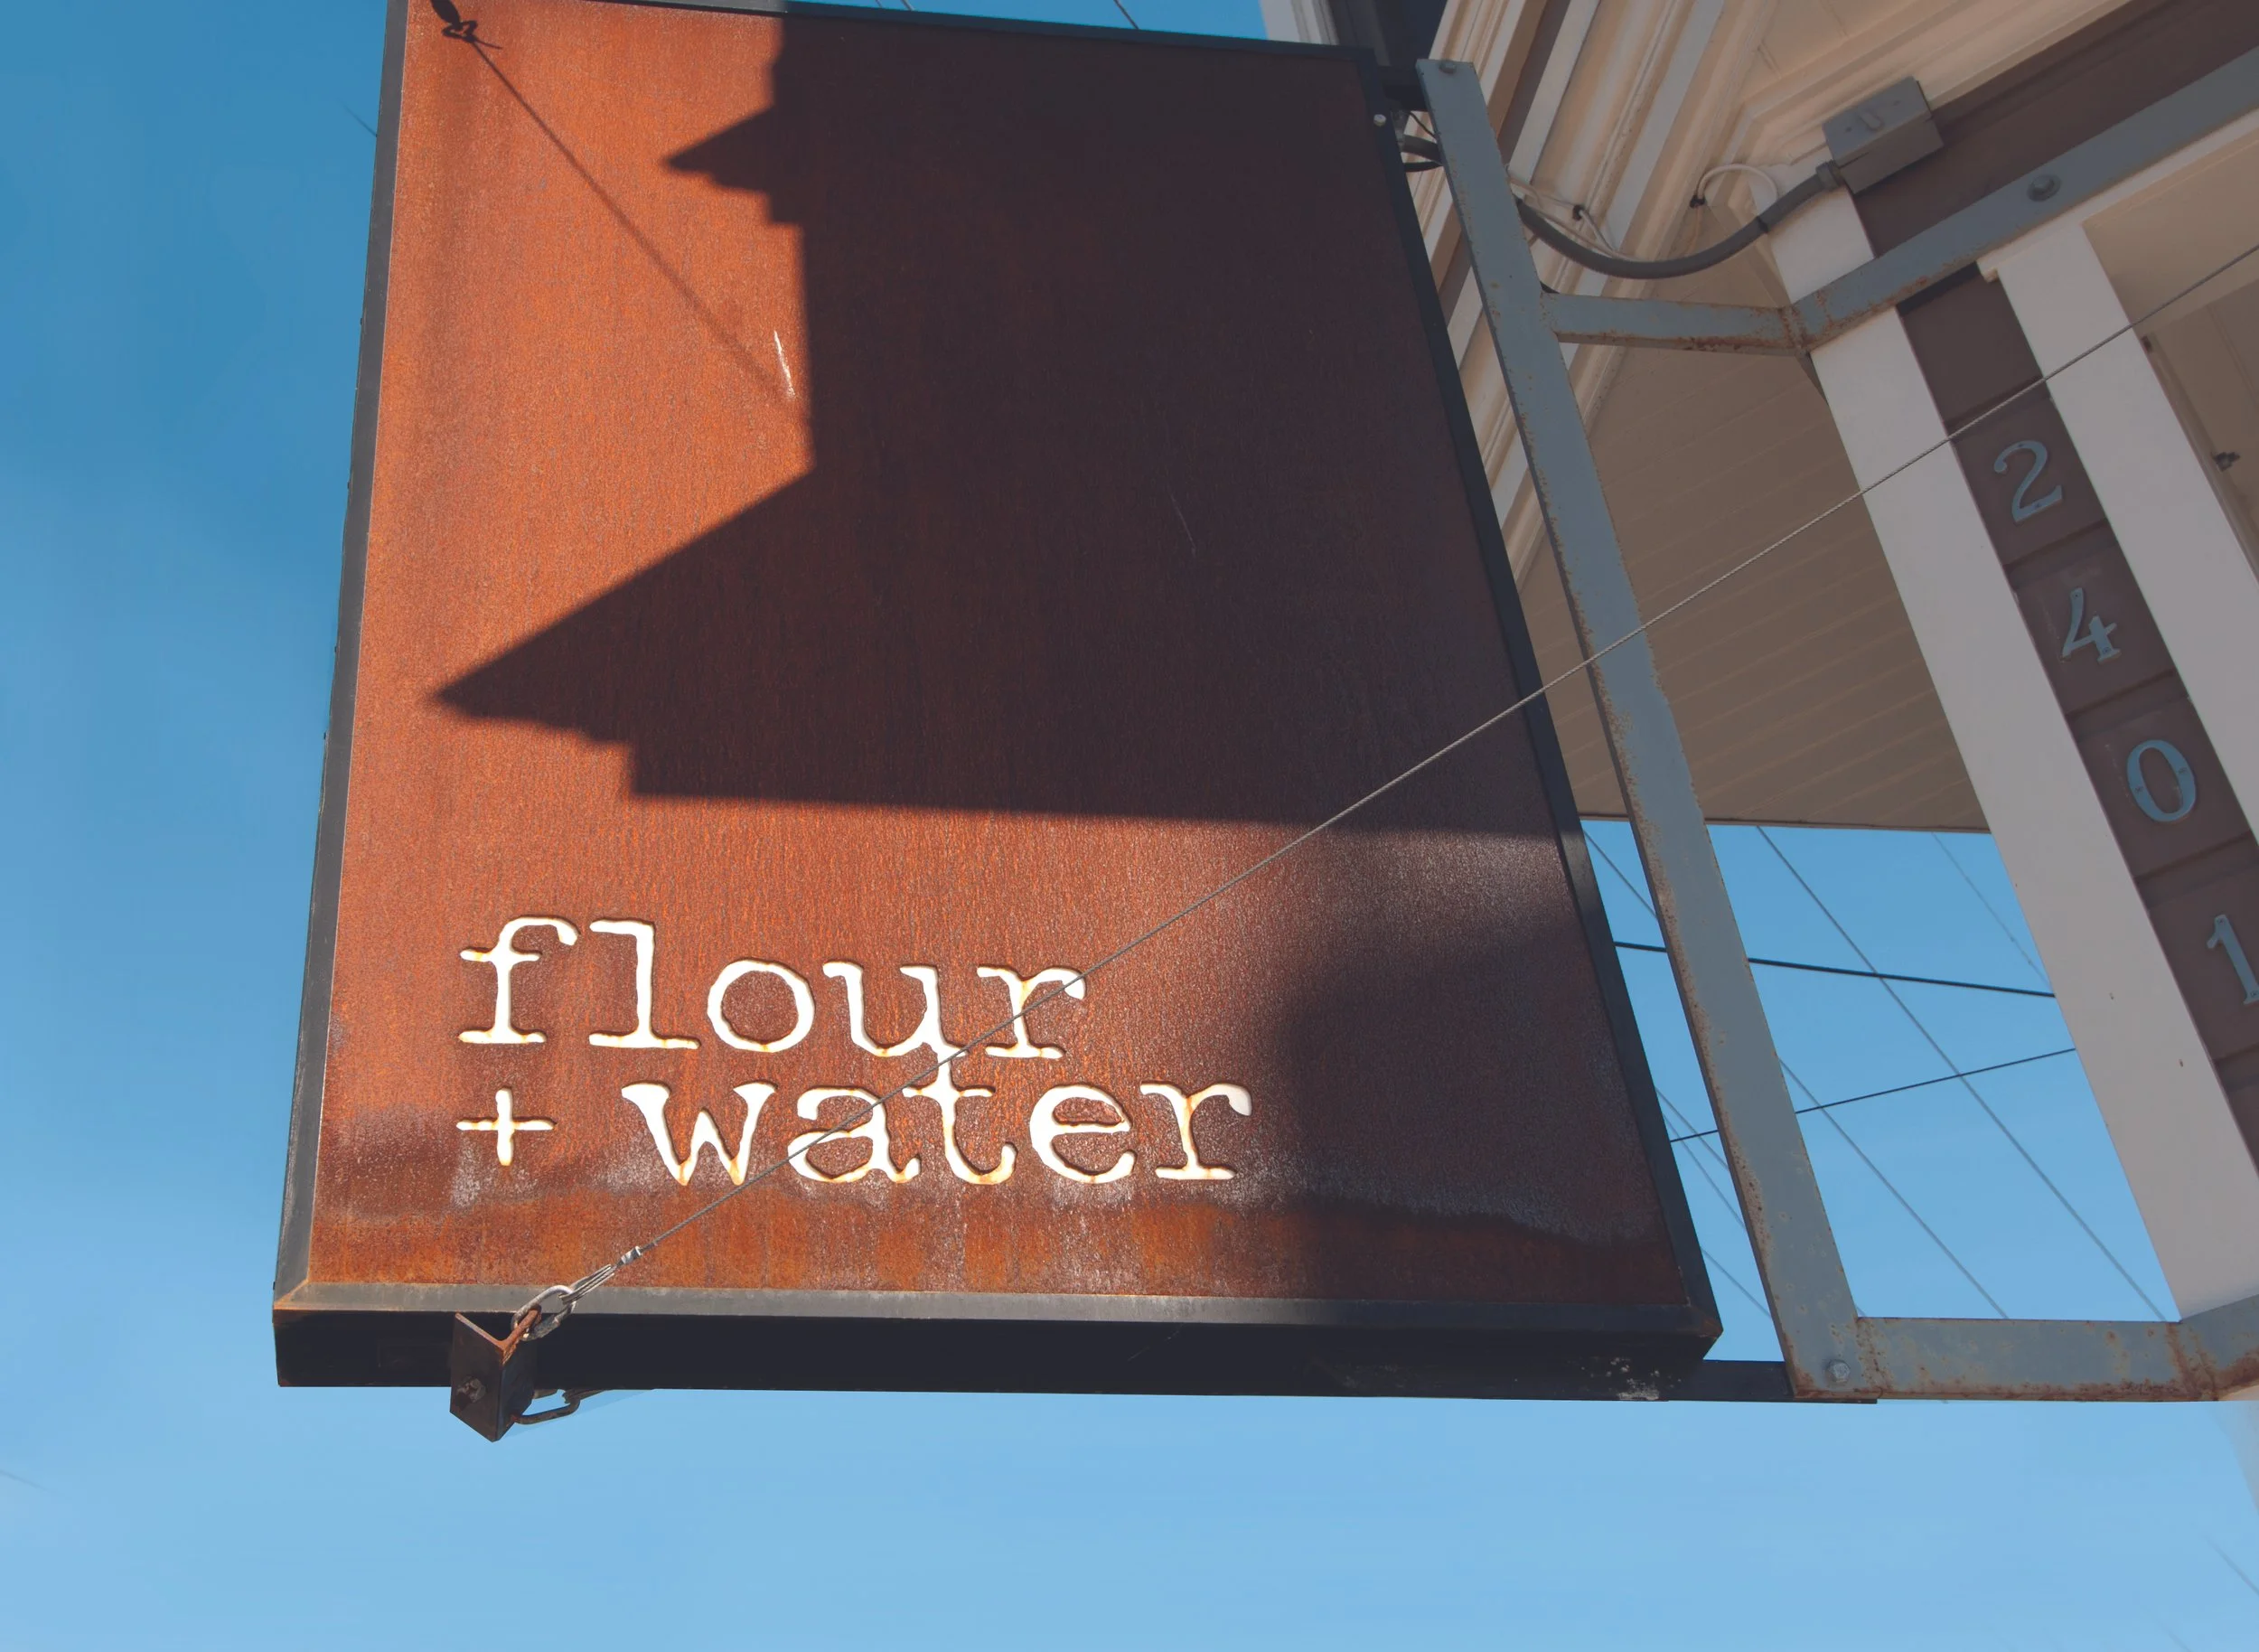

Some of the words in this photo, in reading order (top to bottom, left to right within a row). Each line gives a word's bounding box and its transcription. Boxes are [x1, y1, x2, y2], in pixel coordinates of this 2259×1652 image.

[458, 915, 1084, 1059] flour
[456, 1087, 554, 1166] +
[621, 1048, 1251, 1186] water
